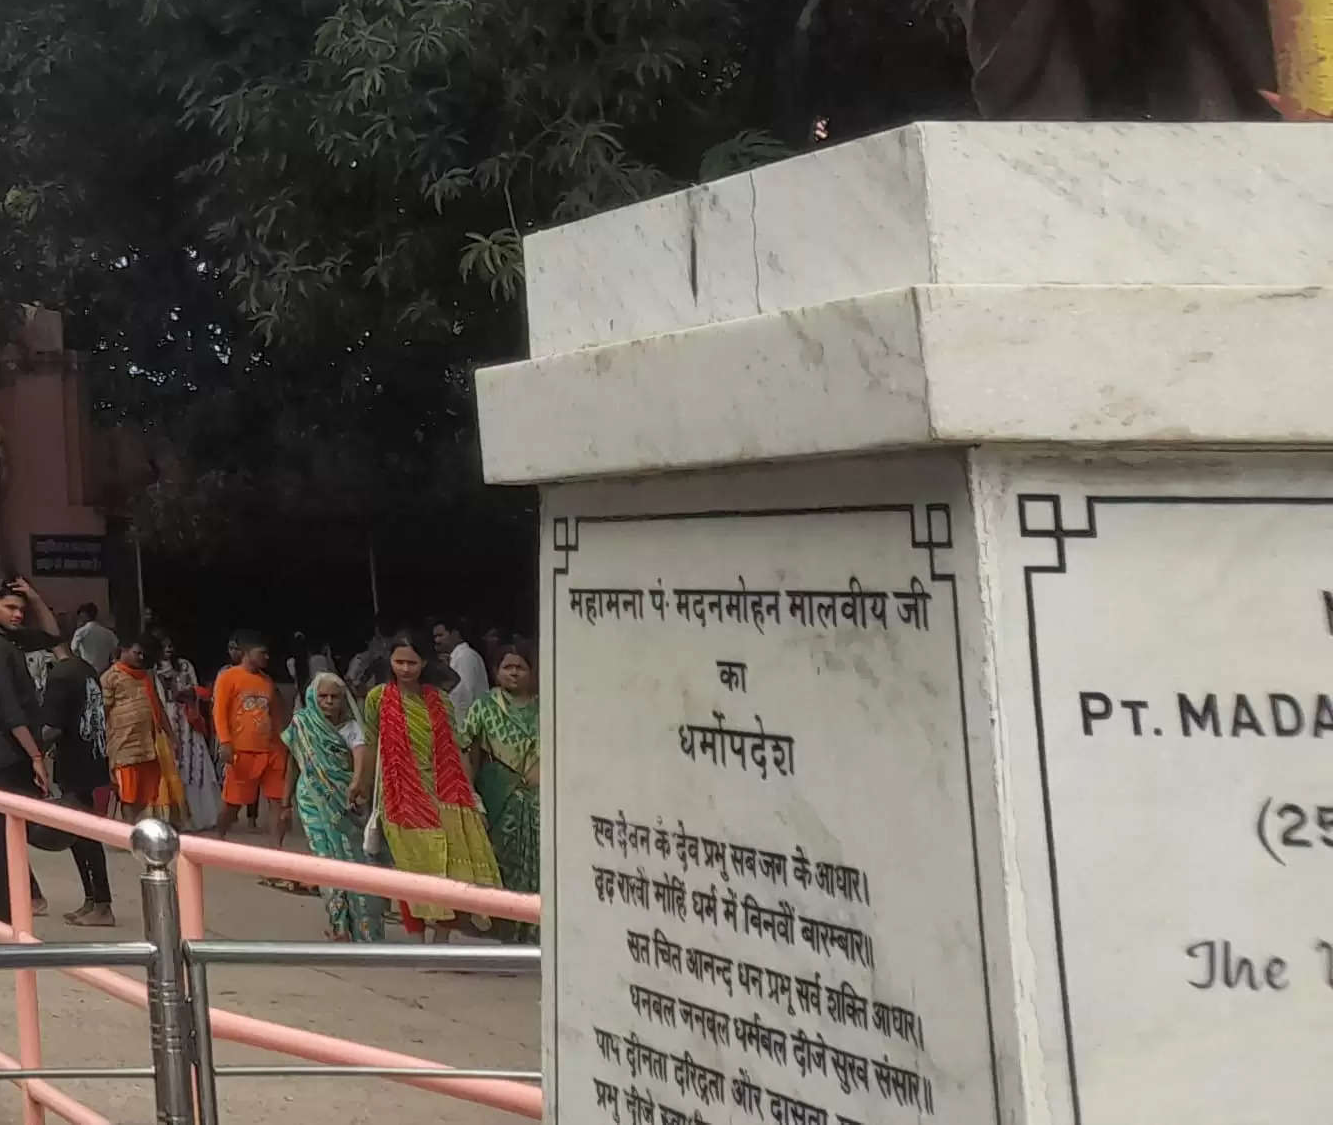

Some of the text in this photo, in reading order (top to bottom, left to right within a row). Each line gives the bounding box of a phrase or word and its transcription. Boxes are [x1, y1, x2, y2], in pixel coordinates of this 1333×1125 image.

[569, 588, 643, 625] महामना
[673, 576, 781, 635] मदनमोहन
[786, 576, 888, 630] मालवीय
[893, 576, 931, 631] जी
[716, 659, 747, 693] का
[1079, 691, 1163, 737] PT.
[679, 710, 794, 780] धर्मोपदेश
[701, 837, 729, 882] प्रभु
[729, 843, 757, 879] सब
[758, 850, 788, 887] जग
[791, 845, 812, 890] के
[692, 883, 717, 925] धर्म
[721, 887, 738, 933] में
[627, 929, 650, 966] सत
[652, 928, 683, 975] चित
[685, 947, 734, 998] आनन्द
[795, 971, 822, 1016] सर्व
[825, 981, 868, 1031] शक्ति
[1185, 940, 1290, 990] The
[629, 984, 677, 1028] धनबल
[678, 997, 731, 1047] जनबल
[733, 1012, 787, 1067] धर्मबल
[594, 1027, 621, 1066] पाप
[623, 1031, 669, 1083] दीनता
[670, 1050, 726, 1107] दरिद्रता
[732, 1067, 765, 1122] और
